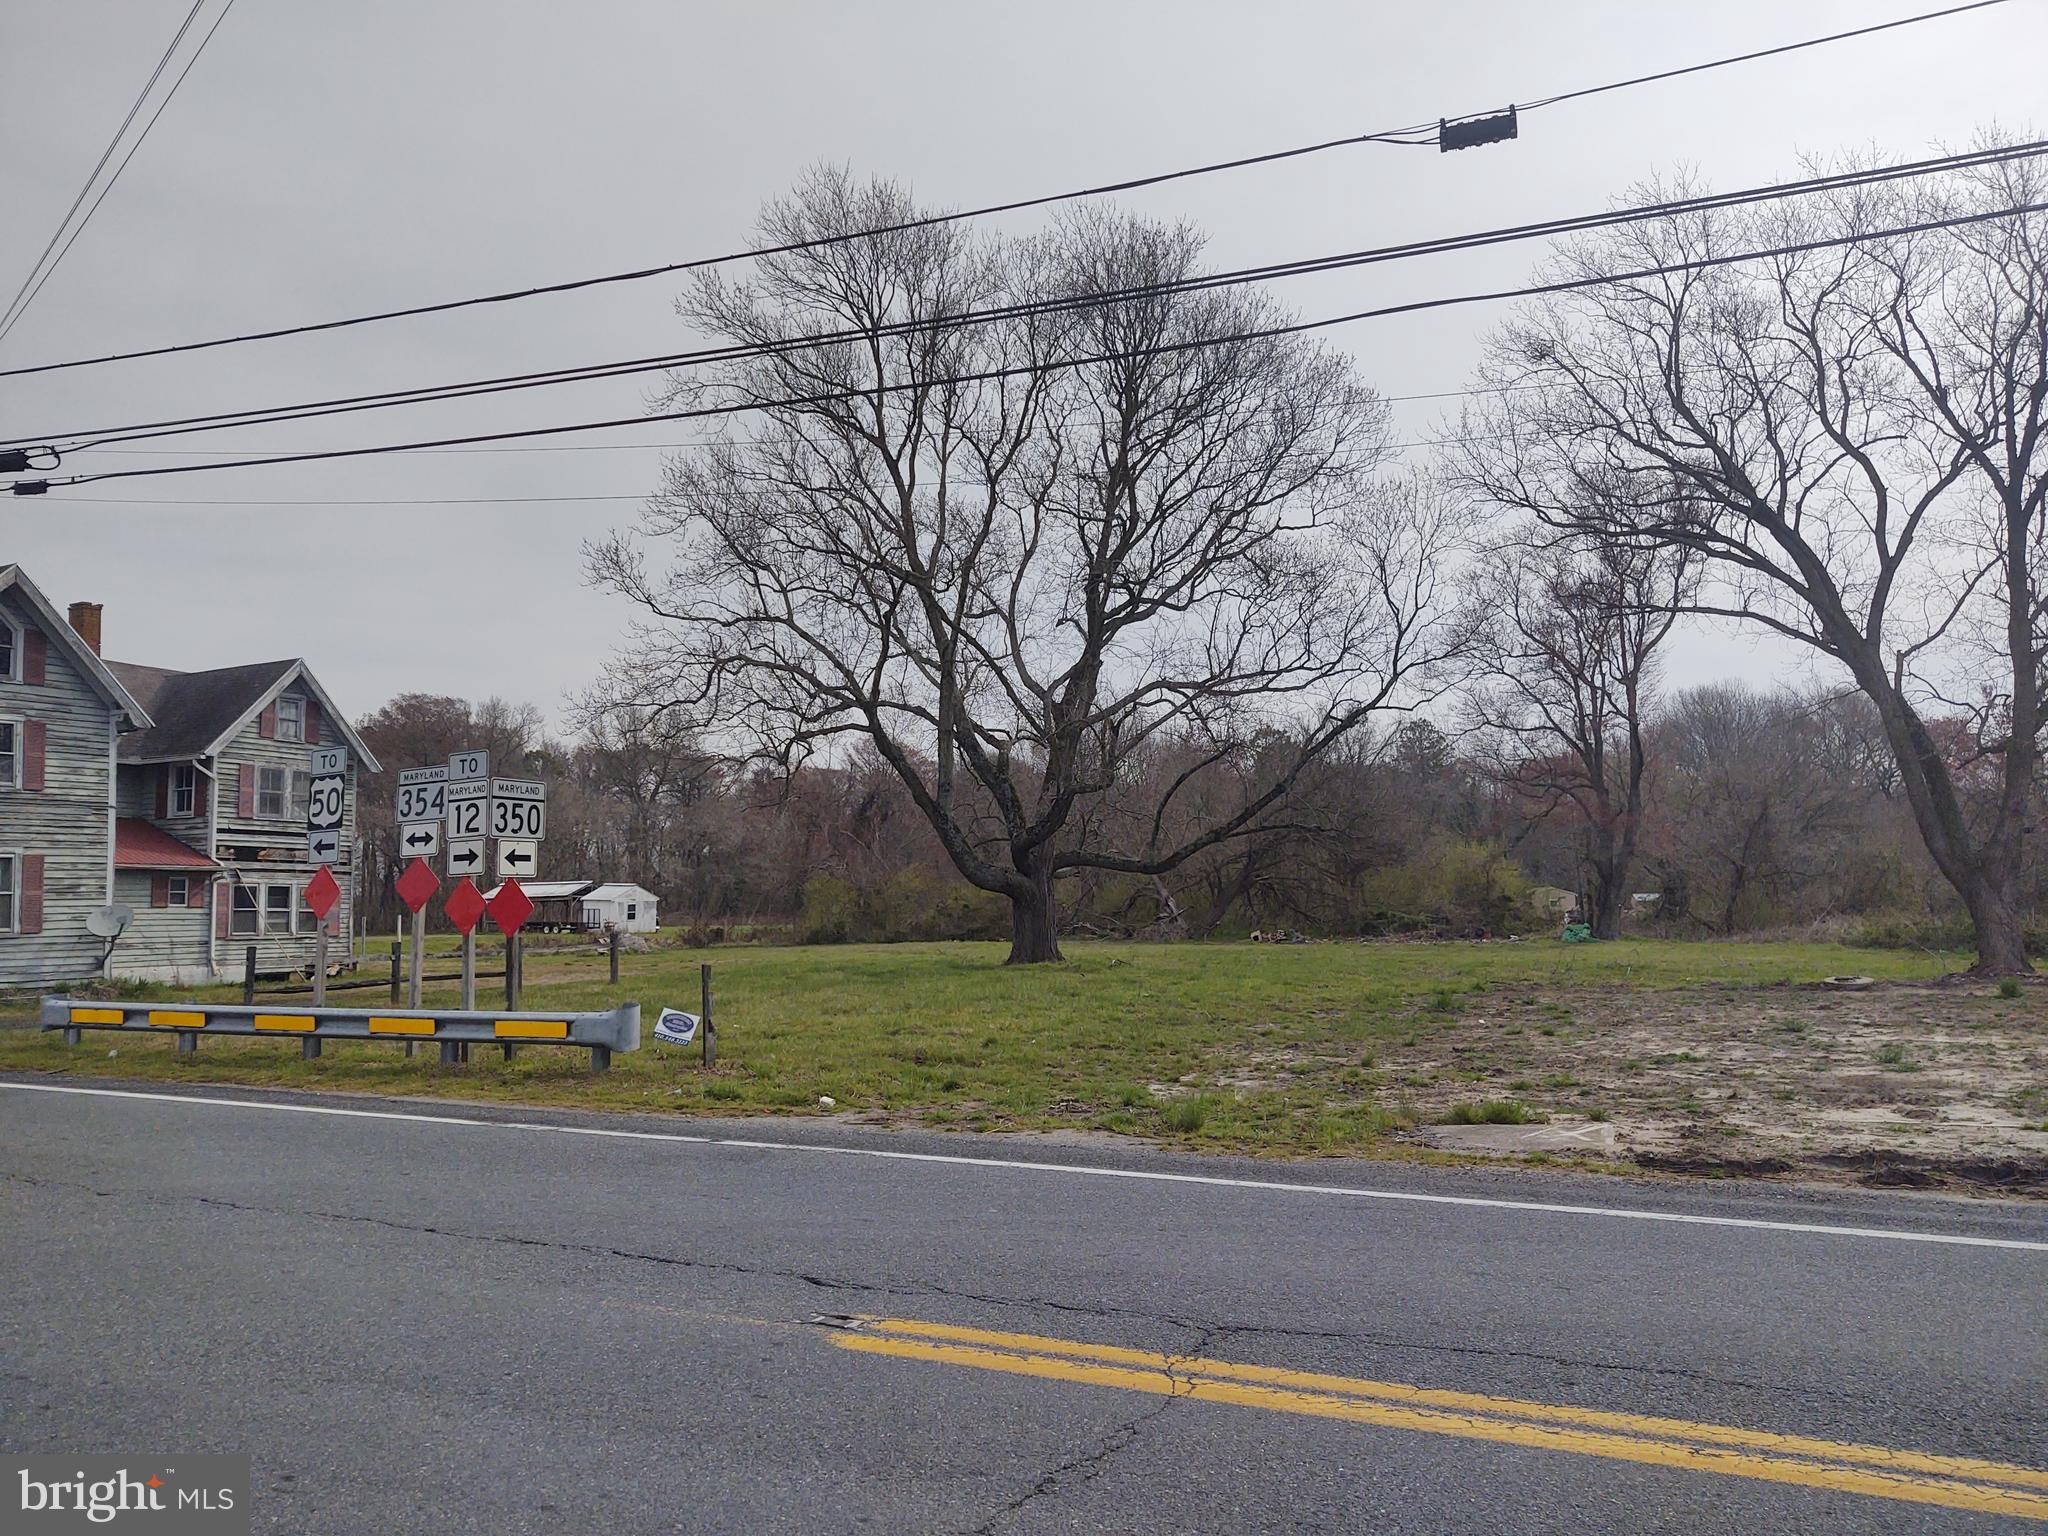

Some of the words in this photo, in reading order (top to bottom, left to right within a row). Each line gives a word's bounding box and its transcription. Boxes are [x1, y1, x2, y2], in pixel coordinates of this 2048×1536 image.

[320, 754, 337, 769] TO
[459, 757, 478, 774] TO
[403, 770, 445, 782] MARYLAND
[449, 783, 487, 797] MARYLAND
[498, 784, 540, 796] MARYLAND
[311, 787, 341, 818] 50
[400, 786, 445, 818] 354
[455, 803, 480, 834] 12
[494, 802, 541, 835] 350
